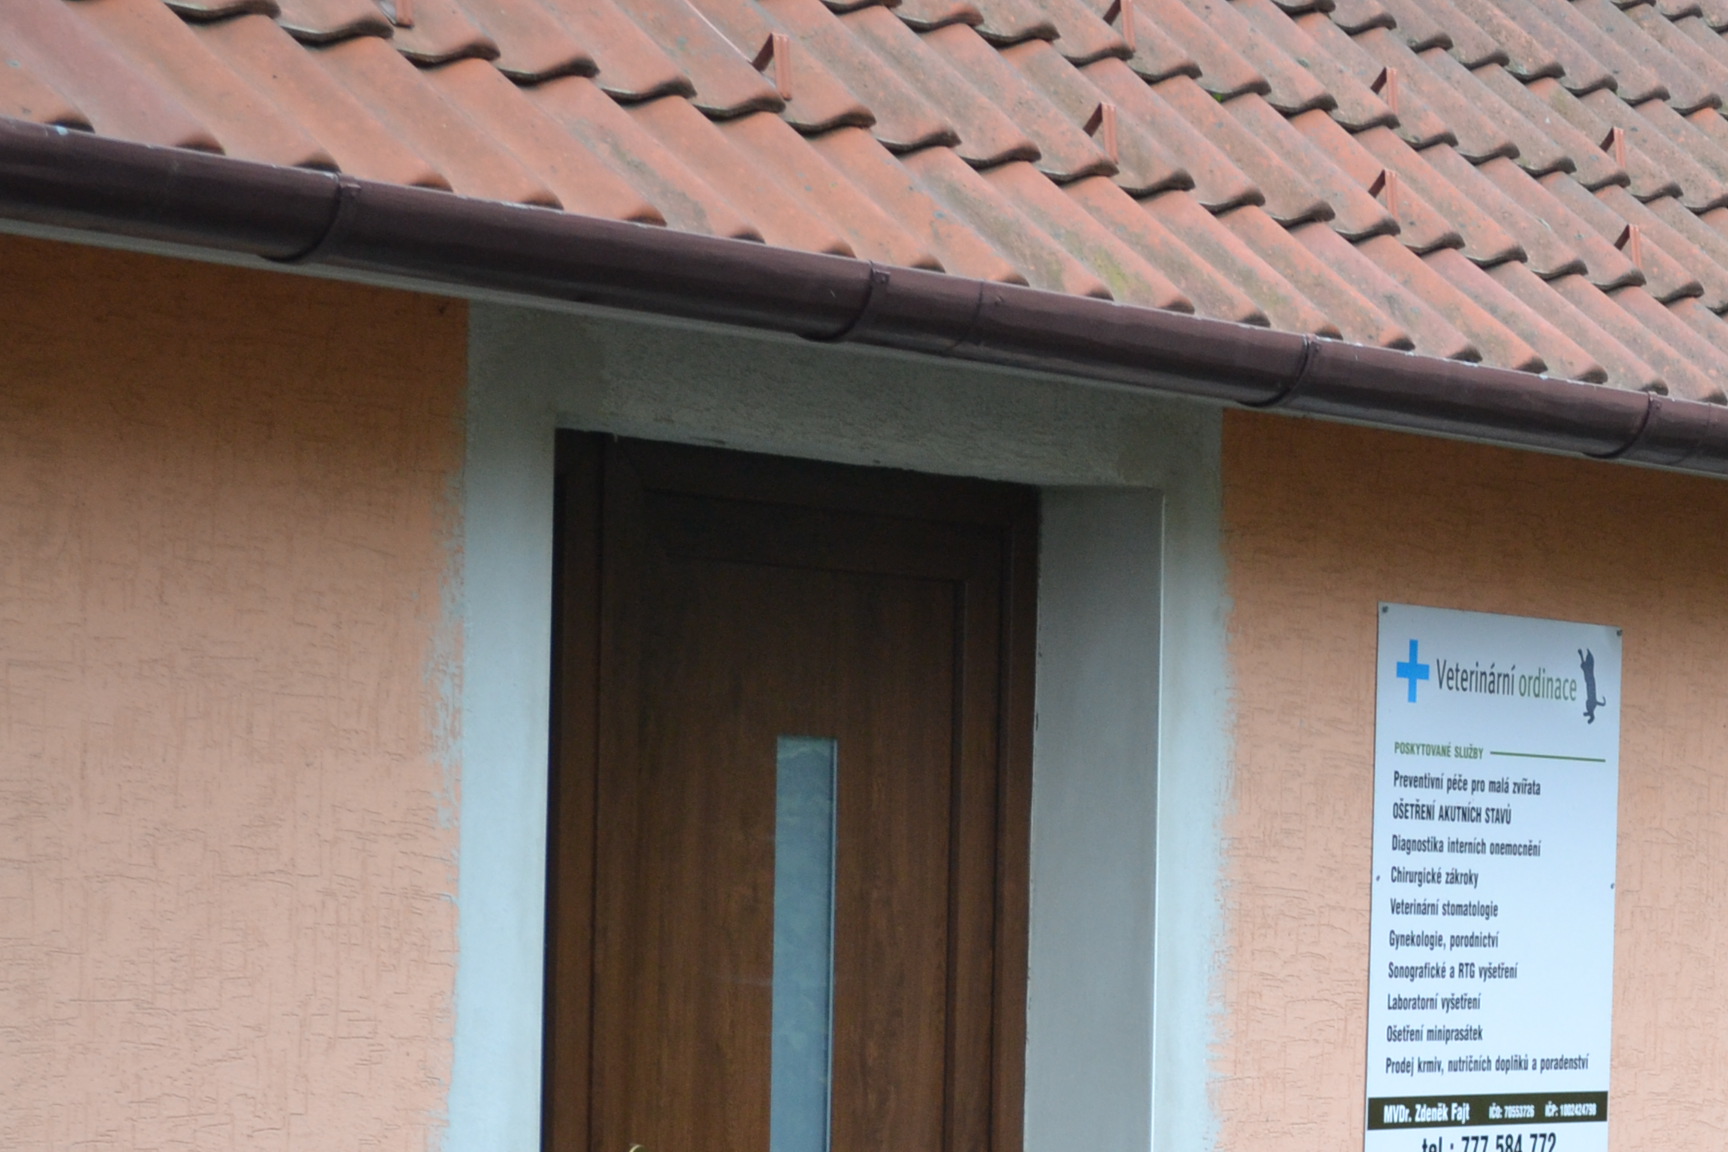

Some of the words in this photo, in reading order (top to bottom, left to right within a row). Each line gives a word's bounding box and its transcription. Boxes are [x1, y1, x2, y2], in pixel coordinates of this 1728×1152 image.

[1436, 658, 1516, 696] Veterinární
[1518, 667, 1577, 701] ordinace
[1394, 742, 1452, 758] POSKYTOVANÉ
[1454, 744, 1484, 760] SLUŽBY
[1394, 770, 1444, 790] Preventivní
[1446, 774, 1468, 794] péče
[1471, 777, 1486, 795] pro
[1488, 776, 1510, 795] malá
[1512, 777, 1541, 796] zvířata
[1392, 798, 1435, 821] OŠETŘENÍ
[1438, 801, 1482, 823] AKUTNÍCH
[1484, 803, 1512, 825] STAVŮ
[1392, 834, 1444, 855] Diagnostika
[1447, 837, 1486, 855] interních
[1490, 840, 1542, 857] onemocnění
[1390, 866, 1442, 888] Chirurgické
[1445, 868, 1479, 889] zákroky
[1390, 898, 1439, 917] Veterinární
[1442, 898, 1498, 920] stomatologie
[1389, 930, 1446, 951] Gynekologie,
[1450, 931, 1500, 951] porodnictví
[1388, 962, 1446, 982] Sonografické
[1450, 966, 1455, 978] a
[1458, 962, 1476, 979] RTG
[1478, 962, 1518, 983] vyšetření
[1388, 993, 1438, 1011] Laboratorní
[1442, 992, 1481, 1013] vyšetření
[1386, 1024, 1424, 1043] Ošetření
[1426, 1024, 1482, 1044] miniprasátek
[1386, 1058, 1414, 1077] Prodej
[1418, 1057, 1444, 1075] krmiv,
[1448, 1054, 1492, 1073] nutričních
[1496, 1054, 1529, 1074] doplňků
[1532, 1056, 1537, 1071] a
[1540, 1053, 1589, 1074] poradenství
[1384, 1104, 1412, 1124] MVDr.
[1414, 1102, 1449, 1122] Zdeněk
[1451, 1102, 1470, 1125] Fajt
